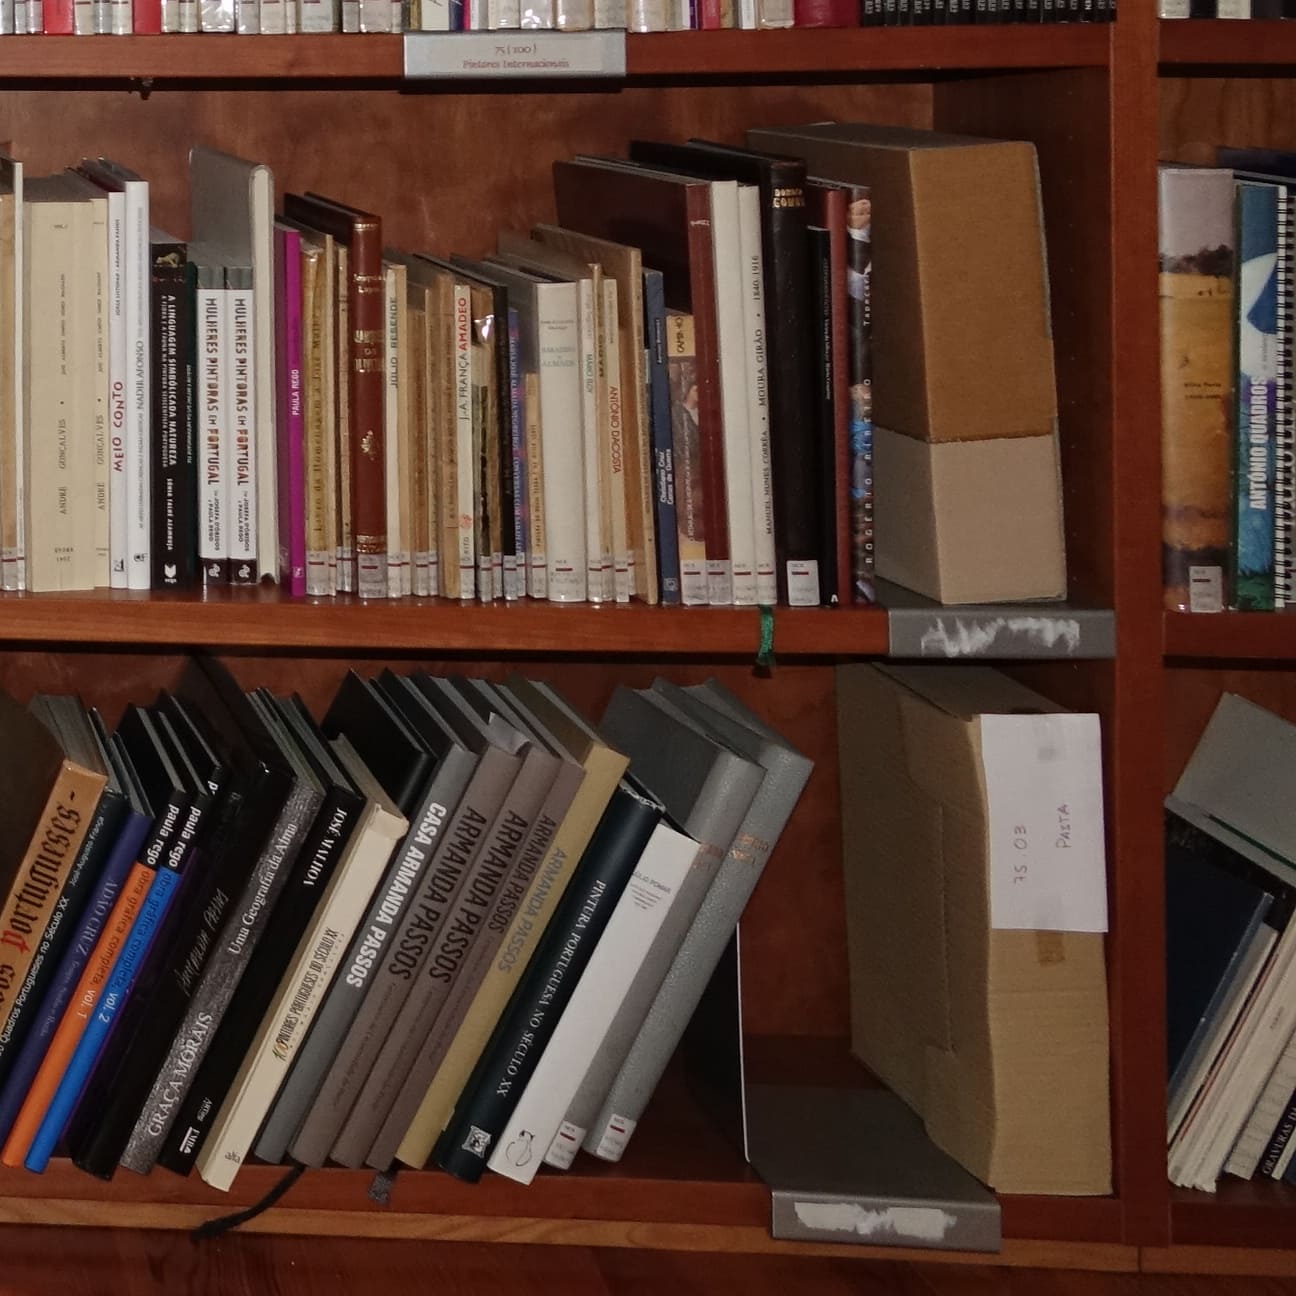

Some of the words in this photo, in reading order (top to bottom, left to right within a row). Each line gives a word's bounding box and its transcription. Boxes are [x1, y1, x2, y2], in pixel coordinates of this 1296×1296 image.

[168, 304, 177, 355] LINGUAGEM
[207, 298, 219, 353] MULHERES
[236, 299, 248, 354] MULHERES
[388, 297, 397, 349] RESENDE
[457, 298, 468, 351] AMADEO
[754, 328, 765, 362] GIRÃO
[207, 357, 220, 411] PINTORAS
[236, 358, 249, 412] PINTORAS
[291, 369, 299, 389] REGO
[459, 354, 470, 398] FRANÇA
[756, 367, 767, 406] MOURA
[111, 381, 125, 428] CONTO
[291, 391, 300, 416] PAULA
[609, 386, 620, 428] ANTÓNIO
[1248, 376, 1269, 444] QUADROS
[58, 419, 68, 469] GONÇALVES
[96, 415, 106, 465] GONÇALVES
[112, 437, 124, 472] MEIO
[168, 421, 177, 465] NATUREZA
[208, 428, 220, 485] PORTUGAL
[237, 429, 249, 486] PORTUGAL
[610, 430, 622, 473] DACOSTA
[1246, 447, 1268, 510] ANTÓNIO
[158, 804, 180, 837] paula
[180, 806, 202, 840] paula
[330, 806, 348, 838] JOSÉ
[415, 802, 448, 846] CASA
[1055, 804, 1072, 850] PASTA
[146, 838, 164, 866] rego
[168, 840, 186, 868] rego
[303, 838, 336, 887] MALHOA
[424, 807, 487, 905] ARMANDA
[464, 810, 529, 908] ARMANDA
[512, 815, 557, 882] ARMANDA
[57, 896, 70, 909] XX
[135, 869, 151, 894] obra
[156, 873, 172, 899] obra
[228, 922, 252, 956] Uma
[242, 864, 276, 928] Geografia
[274, 821, 298, 854] Alma
[375, 846, 425, 925] ARMANDA
[524, 848, 568, 917] ARMANDA
[576, 878, 607, 930] PINTURA
[44, 908, 64, 941] Século
[488, 881, 524, 935] PASSOS
[39, 941, 50, 954] no
[346, 925, 387, 989] PASSOS
[388, 904, 441, 980] PASSOS
[429, 907, 481, 984] PASSOS
[499, 918, 533, 974] PASSOS
[14, 954, 44, 1008] Portugueses
[538, 932, 582, 1005] PORTUGUESA
[0, 1007, 21, 1046] Quadros
[529, 1008, 546, 1029] NO
[147, 1071, 182, 1137] GRAÇA
[174, 1011, 214, 1077] MORAIS
[507, 1029, 535, 1076] SÉCULO
[496, 1078, 513, 1098] XX
